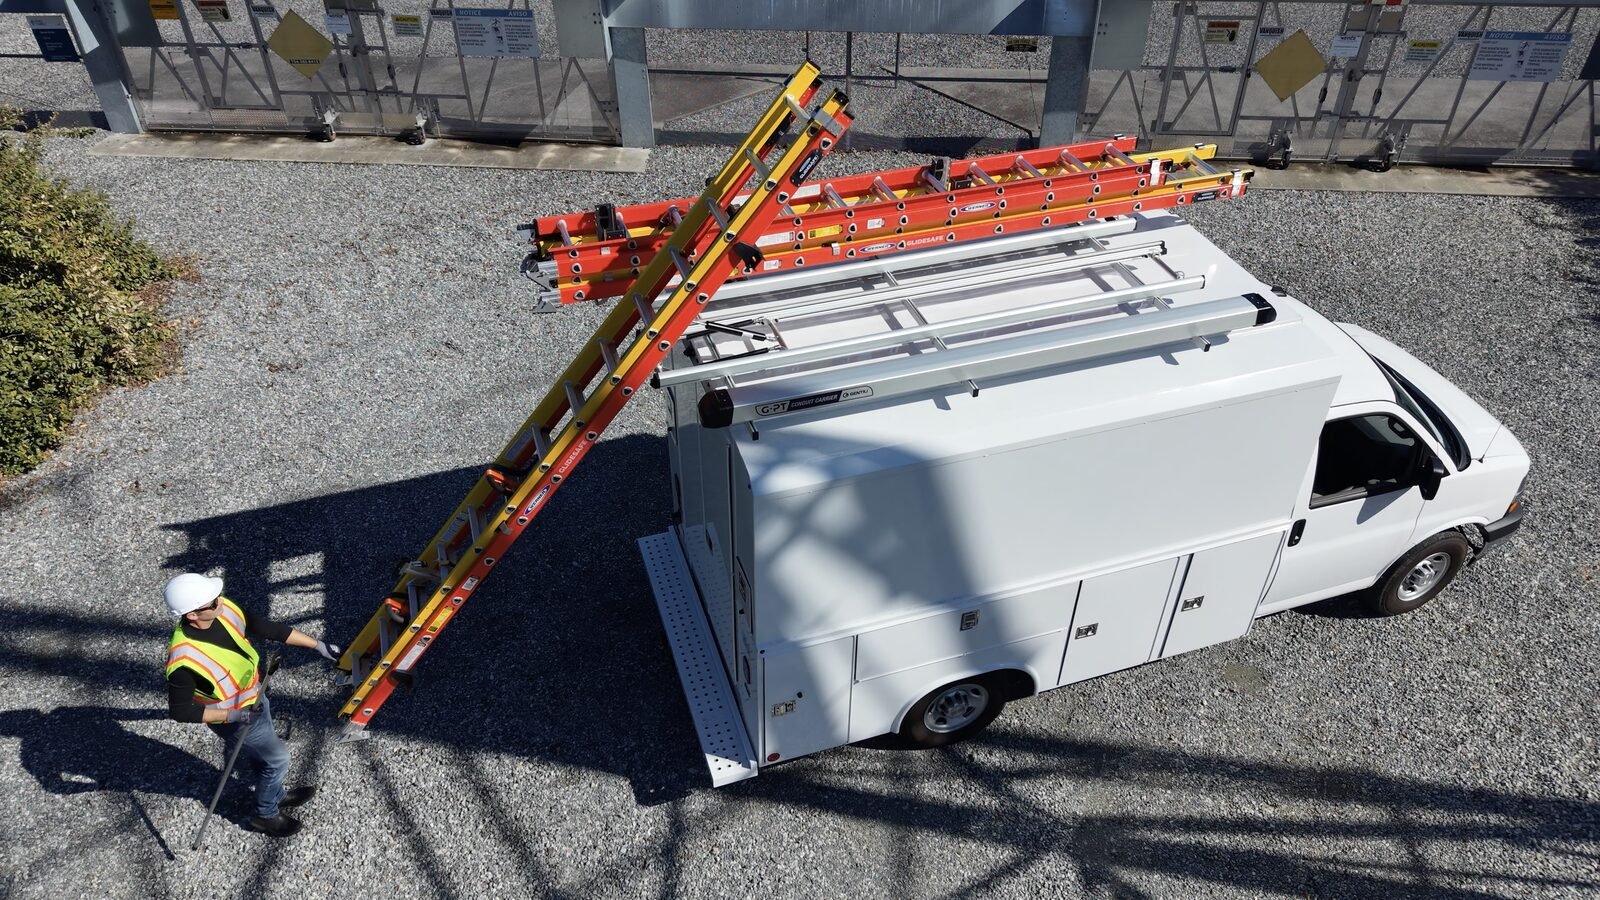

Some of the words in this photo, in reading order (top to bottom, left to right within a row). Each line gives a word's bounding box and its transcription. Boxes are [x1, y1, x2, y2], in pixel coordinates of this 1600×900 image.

[907, 235, 944, 245] GLIDESAFE
[791, 398, 815, 408] CONDUIT
[815, 394, 839, 404] CARRIER
[558, 439, 588, 473] GLIDESAFE
